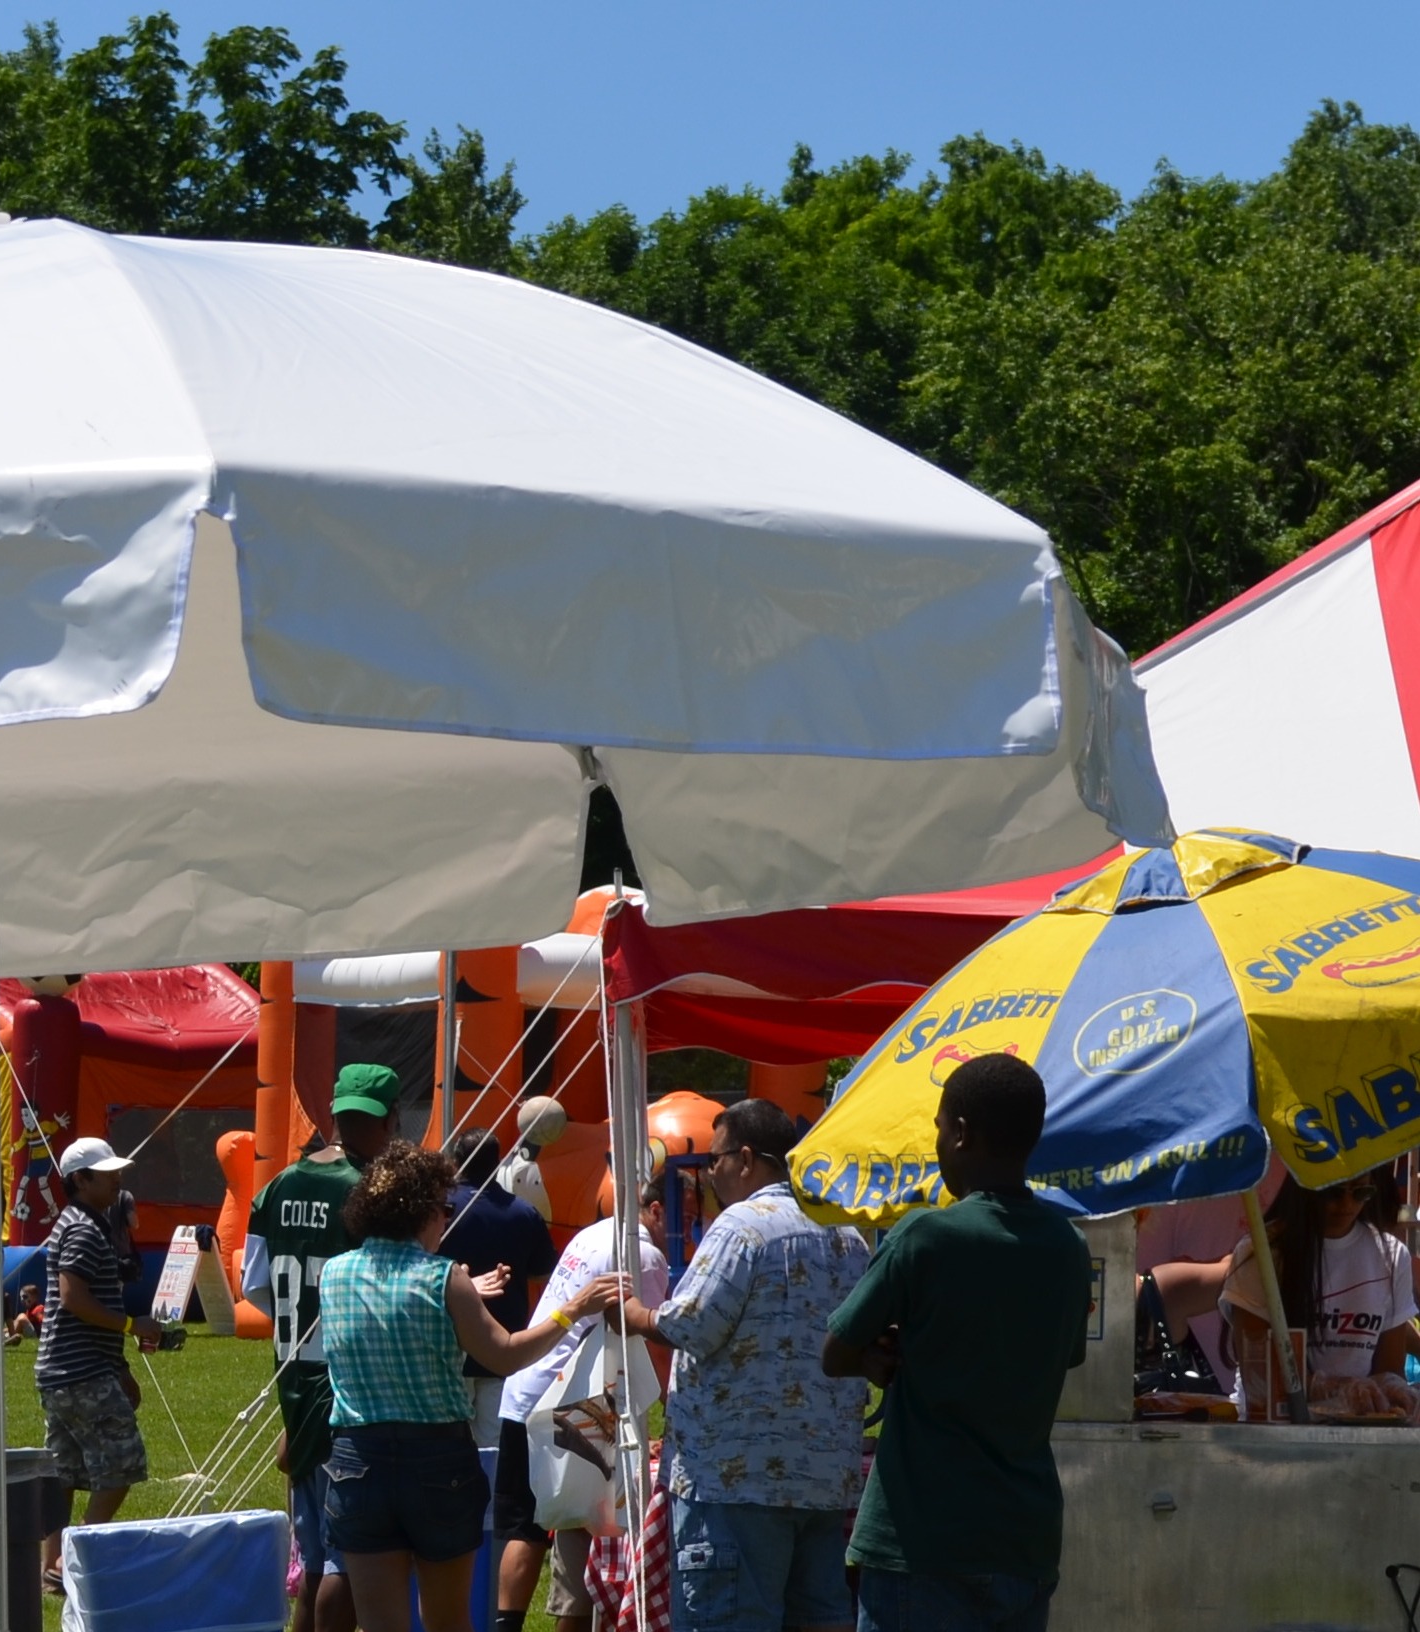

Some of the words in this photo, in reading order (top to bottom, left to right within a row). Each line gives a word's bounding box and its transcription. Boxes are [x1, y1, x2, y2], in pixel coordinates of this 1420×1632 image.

[895, 988, 1062, 1064] SABRETT
[1108, 1017, 1166, 1047] GOV'T
[1121, 1000, 1157, 1021] U.S.
[1089, 1024, 1180, 1067] INSPECTED
[1285, 1051, 1420, 1164] SAB
[1027, 1165, 1095, 1191] WE'RE
[1101, 1159, 1135, 1185] ON
[1138, 1156, 1152, 1176] A
[1157, 1139, 1210, 1169] ROLL
[280, 1199, 330, 1229] COLES
